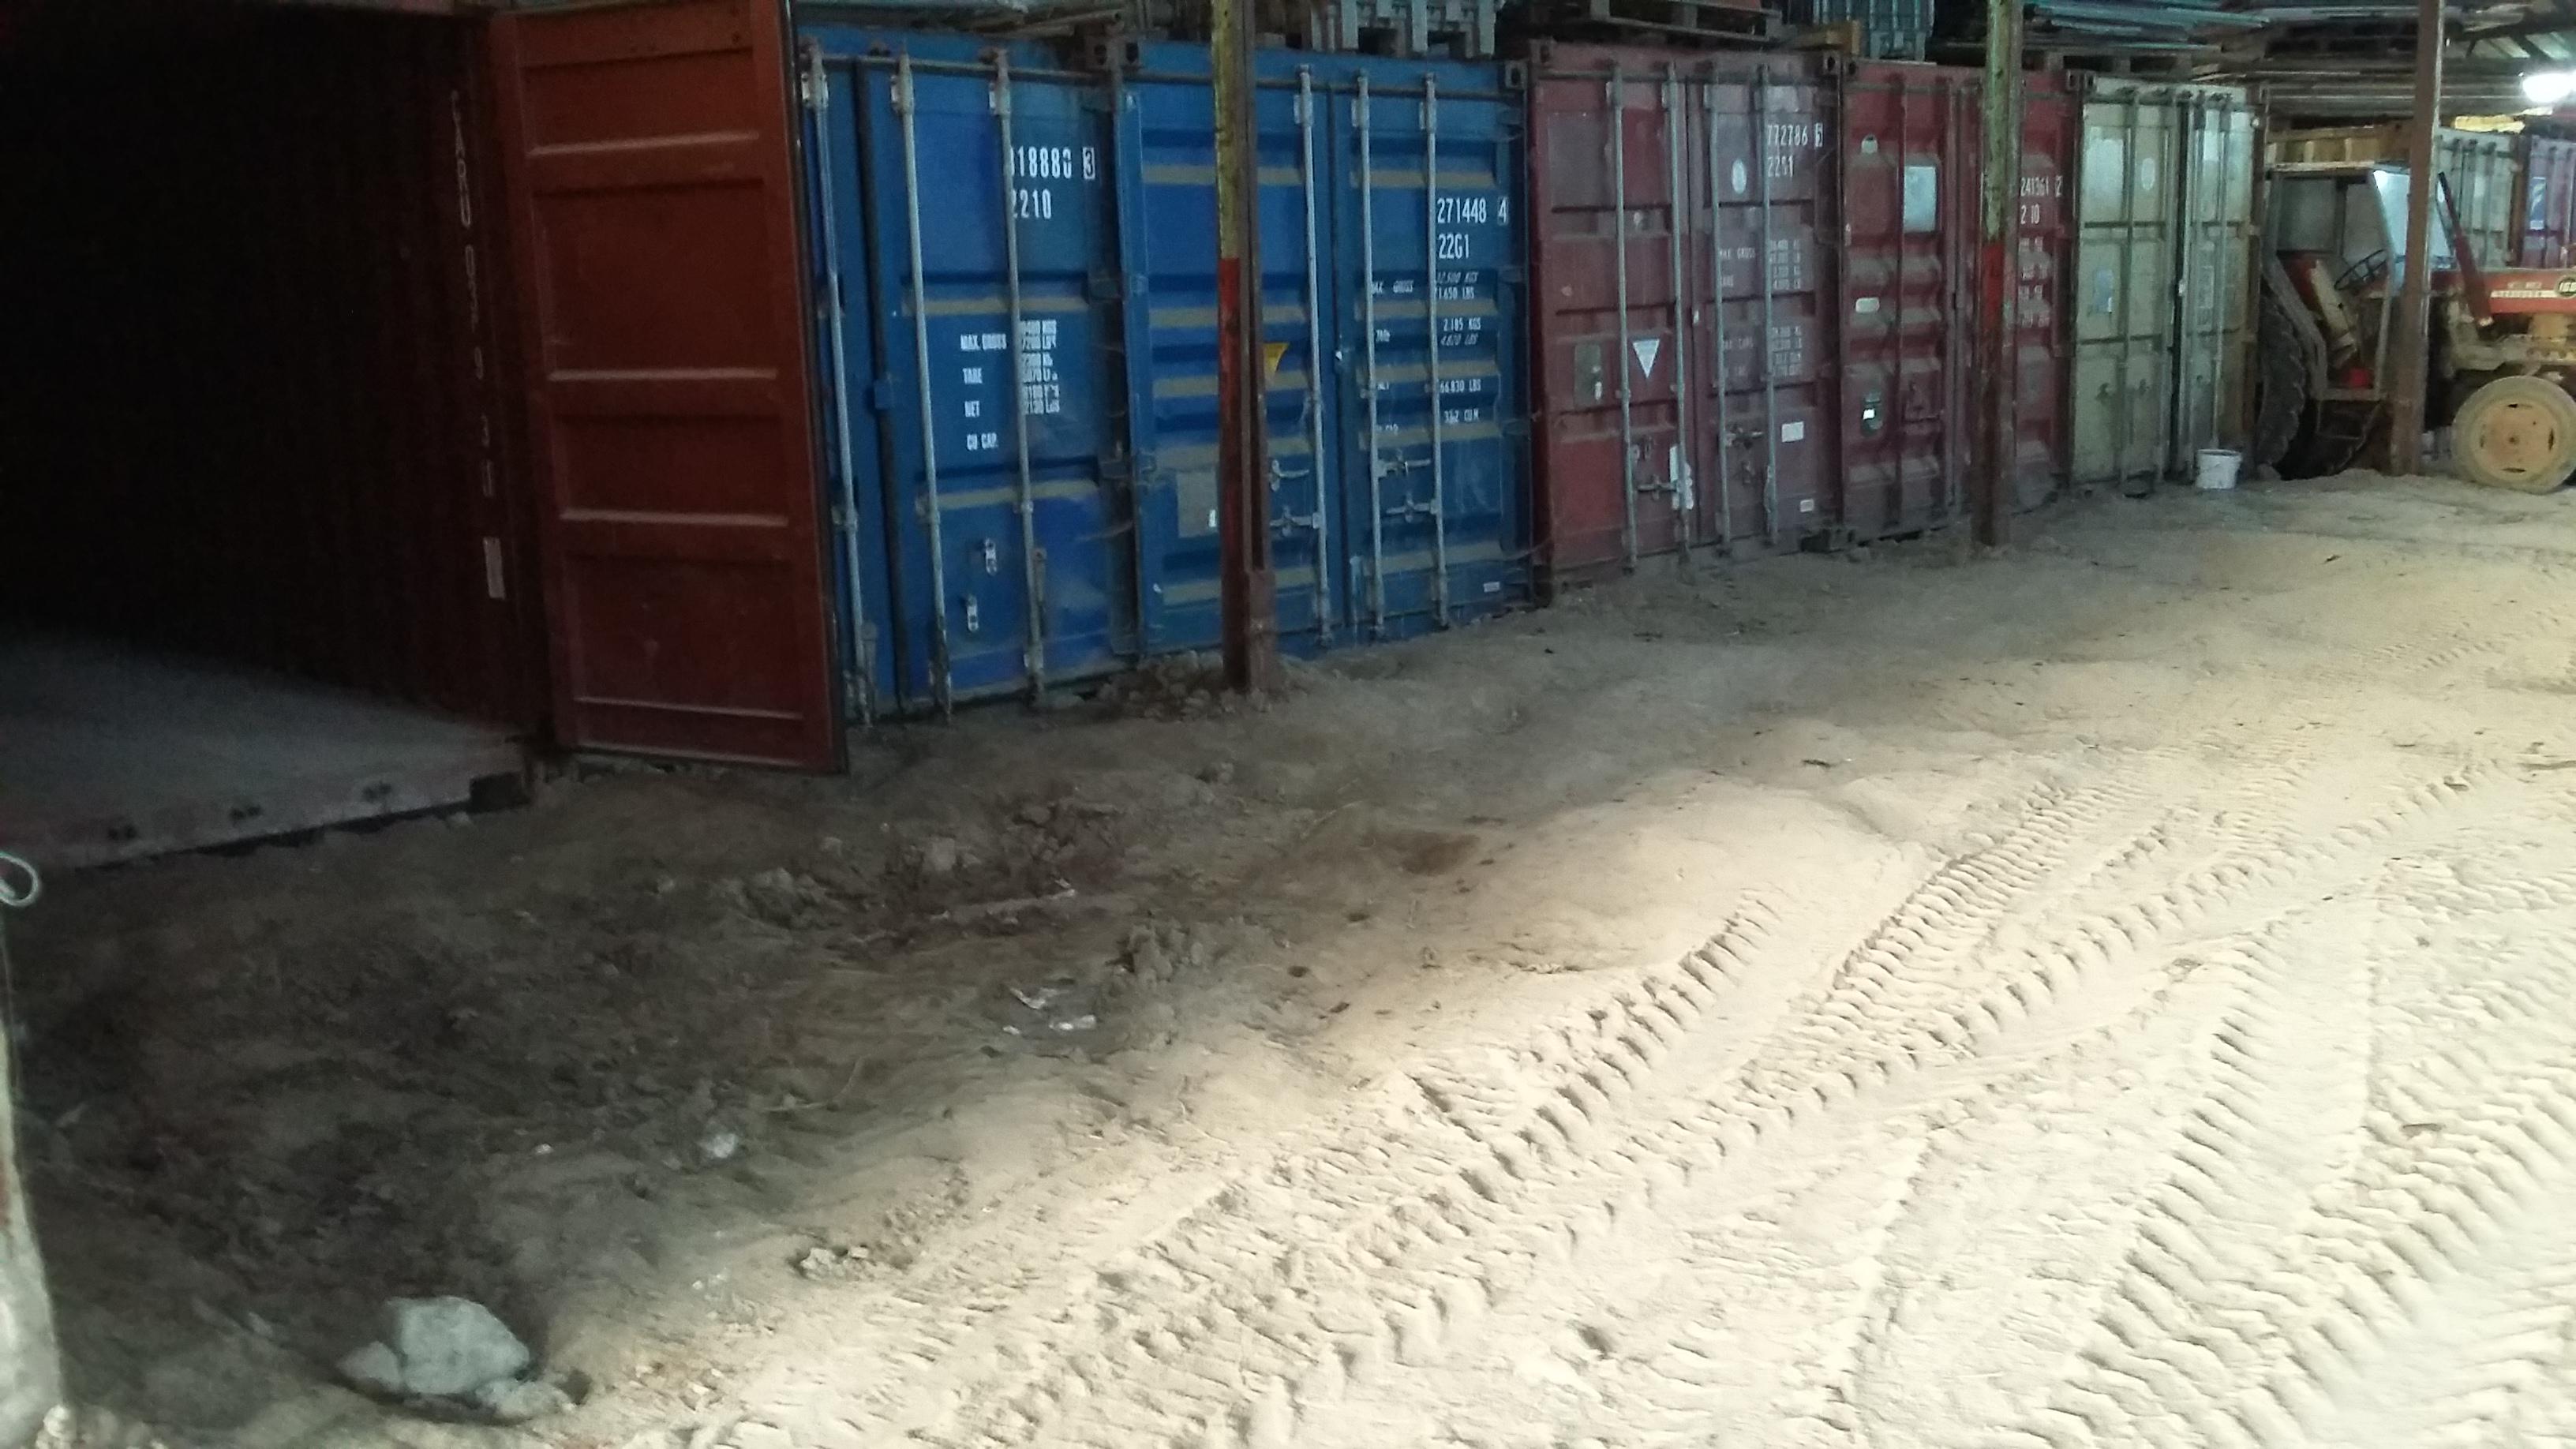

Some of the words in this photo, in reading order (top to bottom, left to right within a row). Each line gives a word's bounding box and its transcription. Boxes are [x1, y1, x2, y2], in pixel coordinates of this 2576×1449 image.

[1082, 147, 1095, 180] 3
[1011, 189, 1052, 219] 2210
[1436, 197, 1487, 224] 271448
[1498, 196, 1508, 226] 4
[1438, 233, 1470, 259] 22G1
